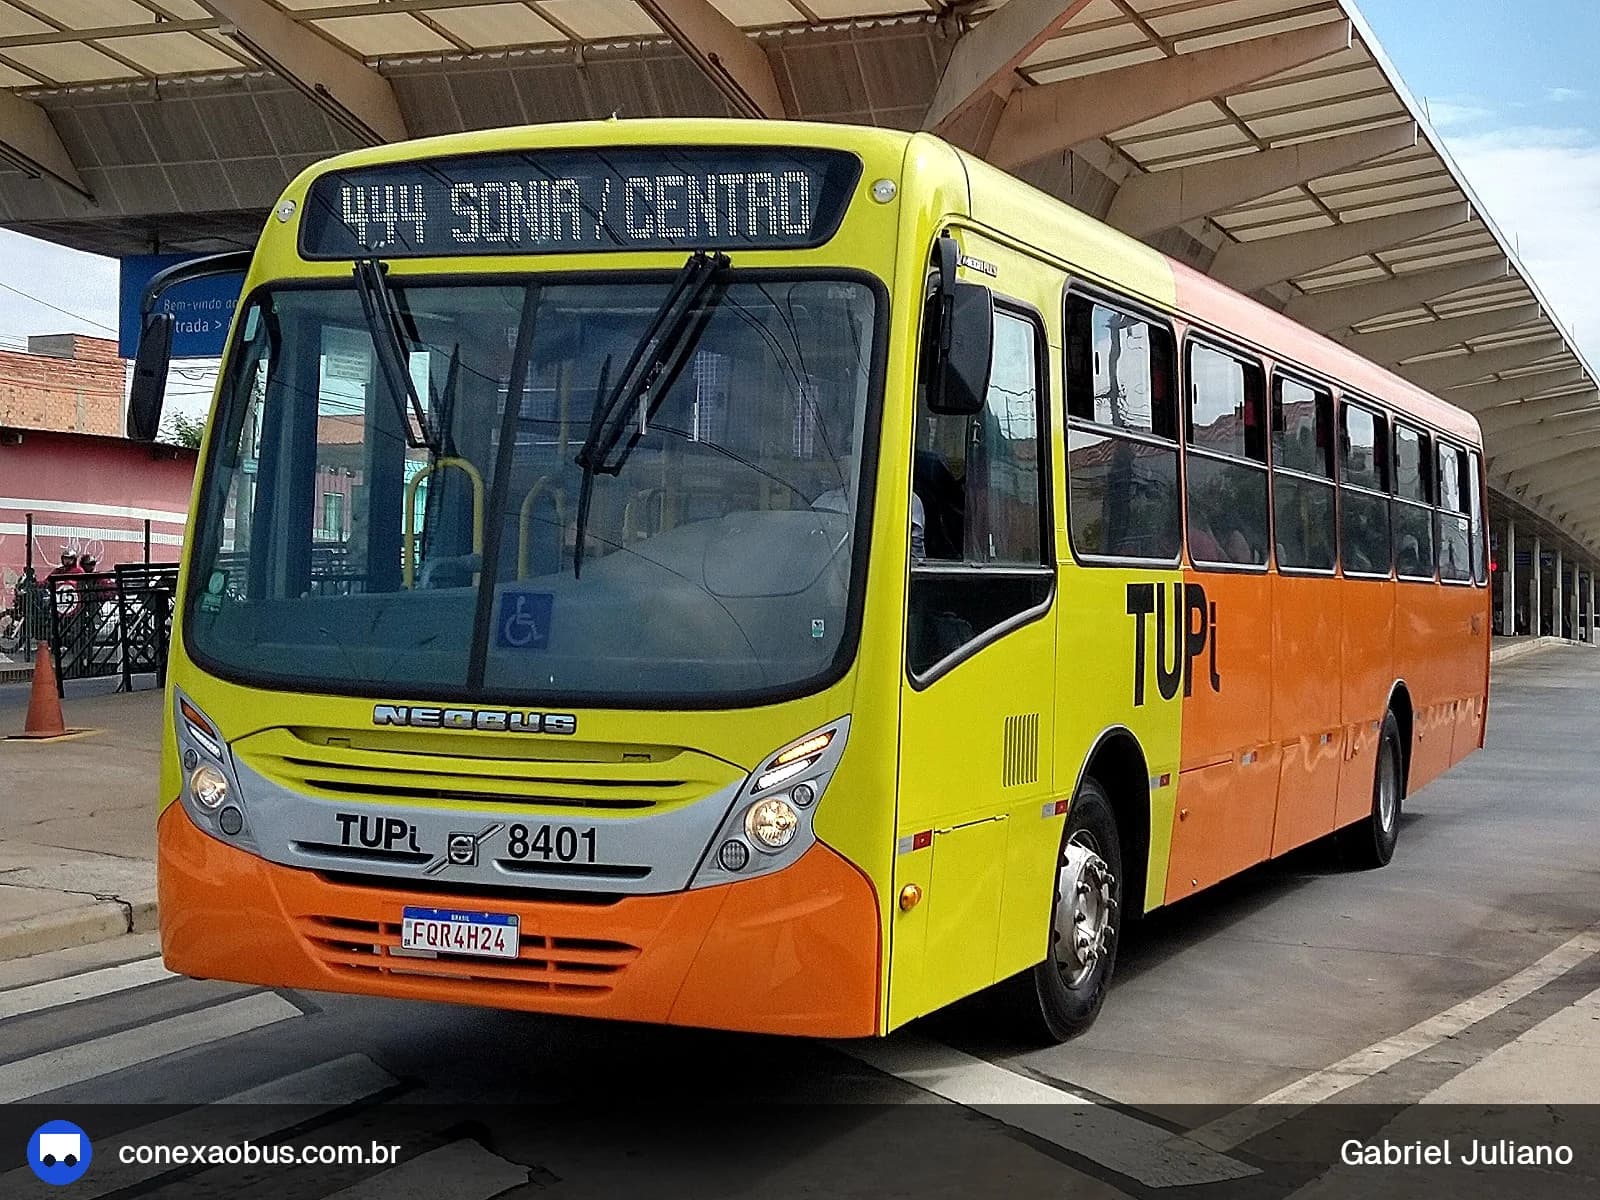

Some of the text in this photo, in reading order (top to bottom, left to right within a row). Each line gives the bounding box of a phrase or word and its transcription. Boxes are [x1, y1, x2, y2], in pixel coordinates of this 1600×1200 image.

[342, 184, 427, 245] 444
[451, 178, 582, 243] SONIA
[625, 171, 810, 240] CENTRO
[164, 298, 221, 312] Bem-vindo
[175, 318, 208, 333] trada
[1126, 582, 1220, 706] TUPi
[373, 704, 577, 735] NEOBUS
[335, 813, 421, 853] TUPi
[508, 823, 596, 863] 8401
[413, 922, 505, 952] FQR4H24
